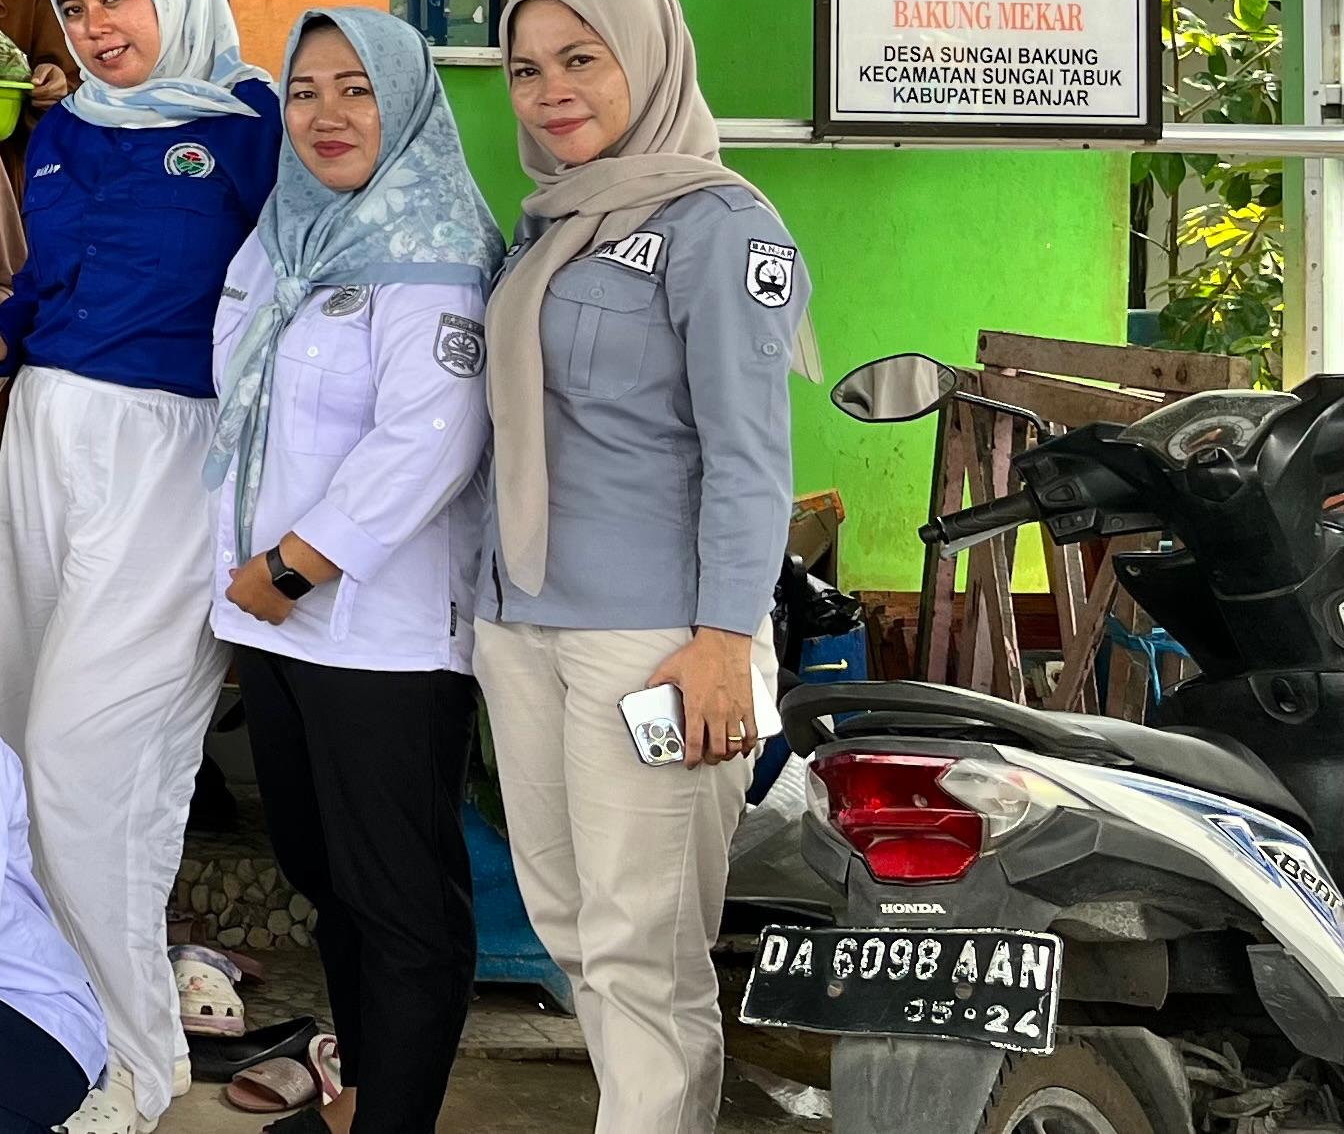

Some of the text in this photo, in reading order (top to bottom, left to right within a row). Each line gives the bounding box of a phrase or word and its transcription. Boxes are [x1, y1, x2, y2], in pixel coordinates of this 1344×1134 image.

[894, 0, 1084, 32] BAKUNG MEKAR
[884, 46, 1098, 65] DESA SUNGAI BAKUNG
[859, 66, 1122, 87] KECAMATAN SUNGAI TABUK
[893, 87, 1089, 106] KABUPATEN BANJAR
[880, 903, 946, 914] HONDA
[760, 934, 1051, 990] DA 6098 AAN
